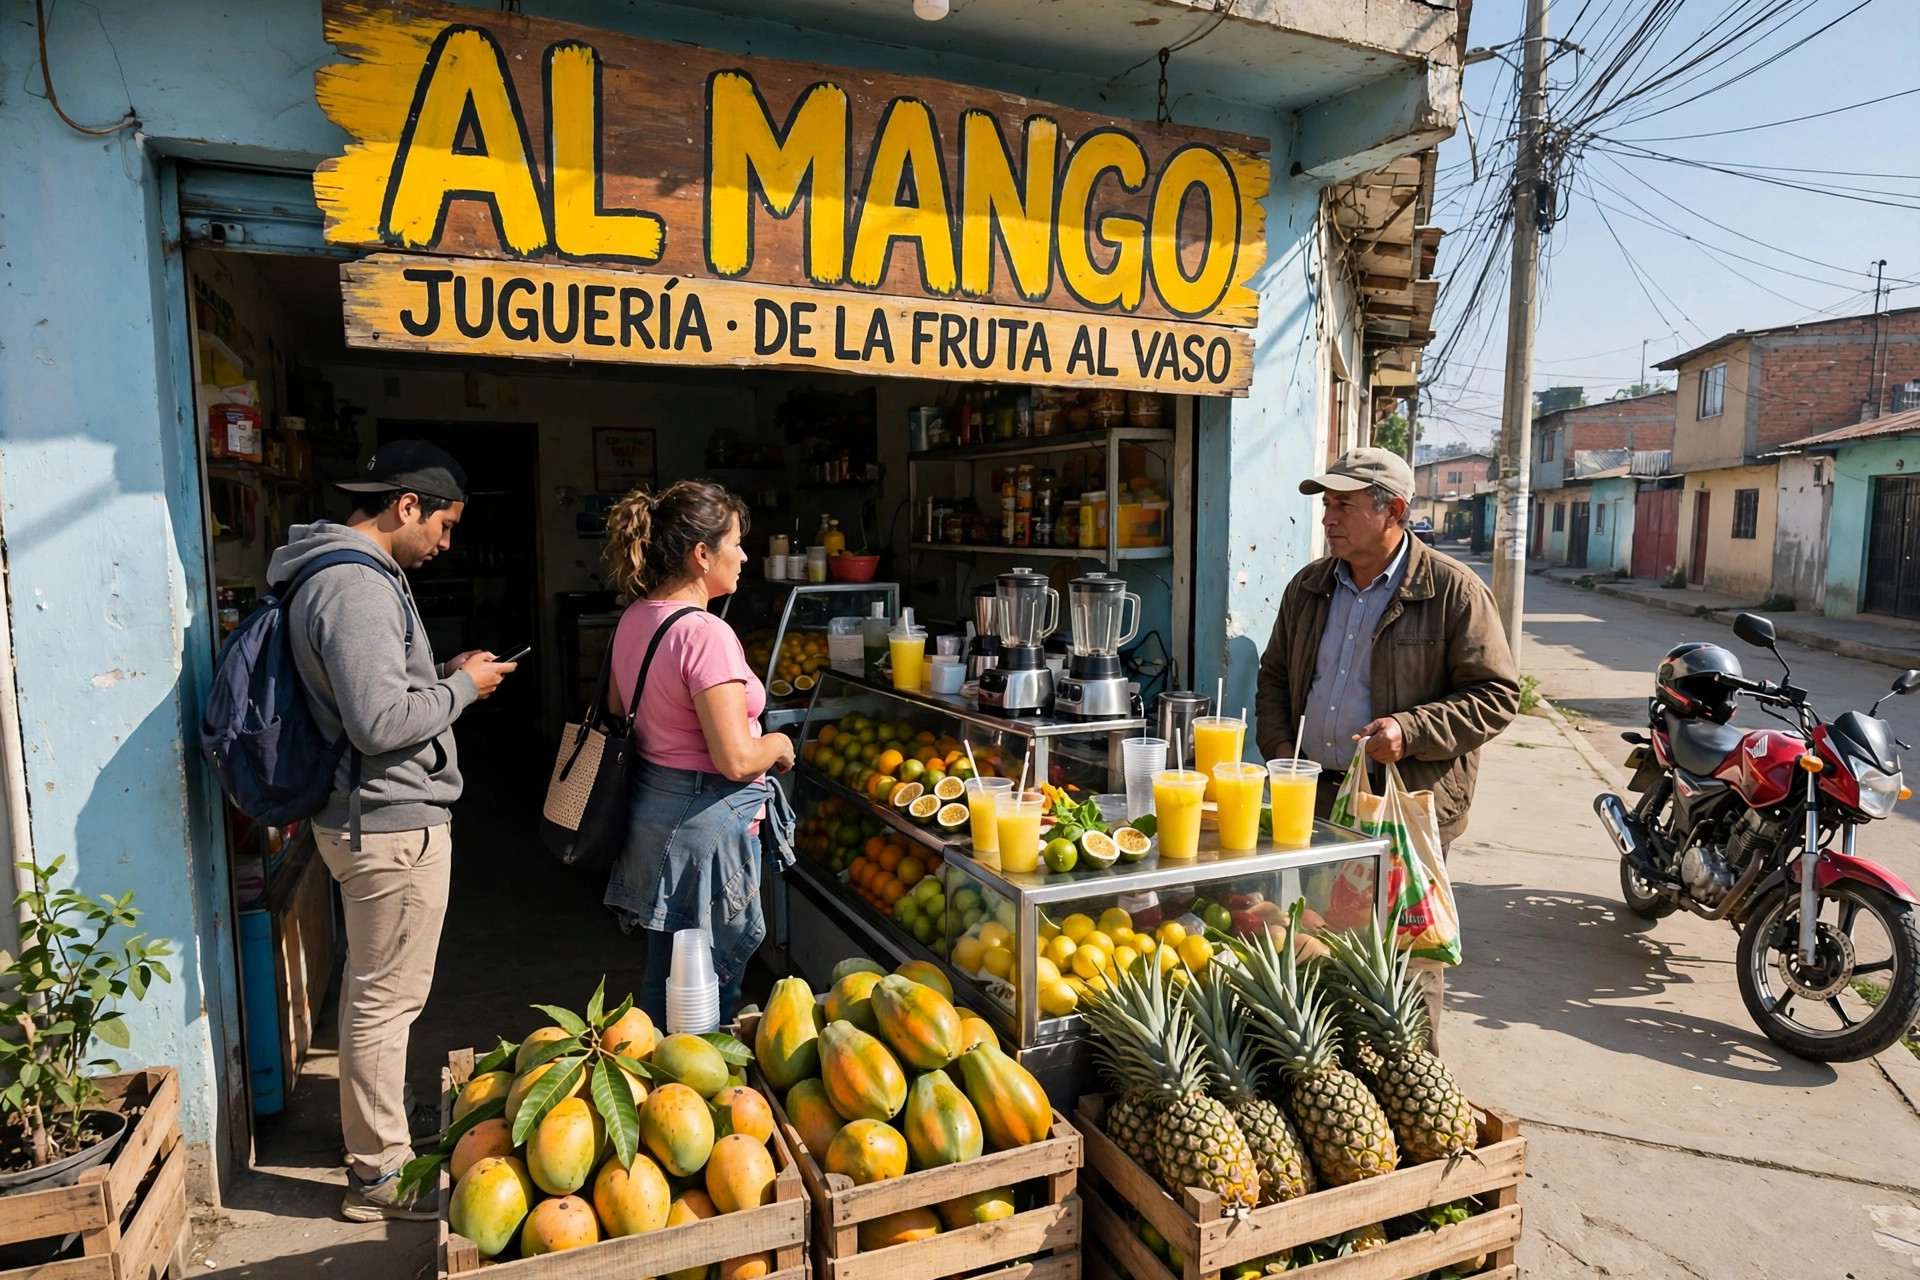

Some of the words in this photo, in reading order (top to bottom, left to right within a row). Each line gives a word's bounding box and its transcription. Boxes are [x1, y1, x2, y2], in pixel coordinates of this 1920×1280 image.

[379, 23, 666, 266] AL
[703, 67, 1242, 319] MANGO
[400, 269, 712, 352] JUGUERÍA
[755, 299, 816, 357] DE
[835, 306, 894, 363] LA
[912, 312, 1051, 372] FRUTA
[1067, 325, 1119, 376] AL
[1132, 330, 1231, 383] VASO
